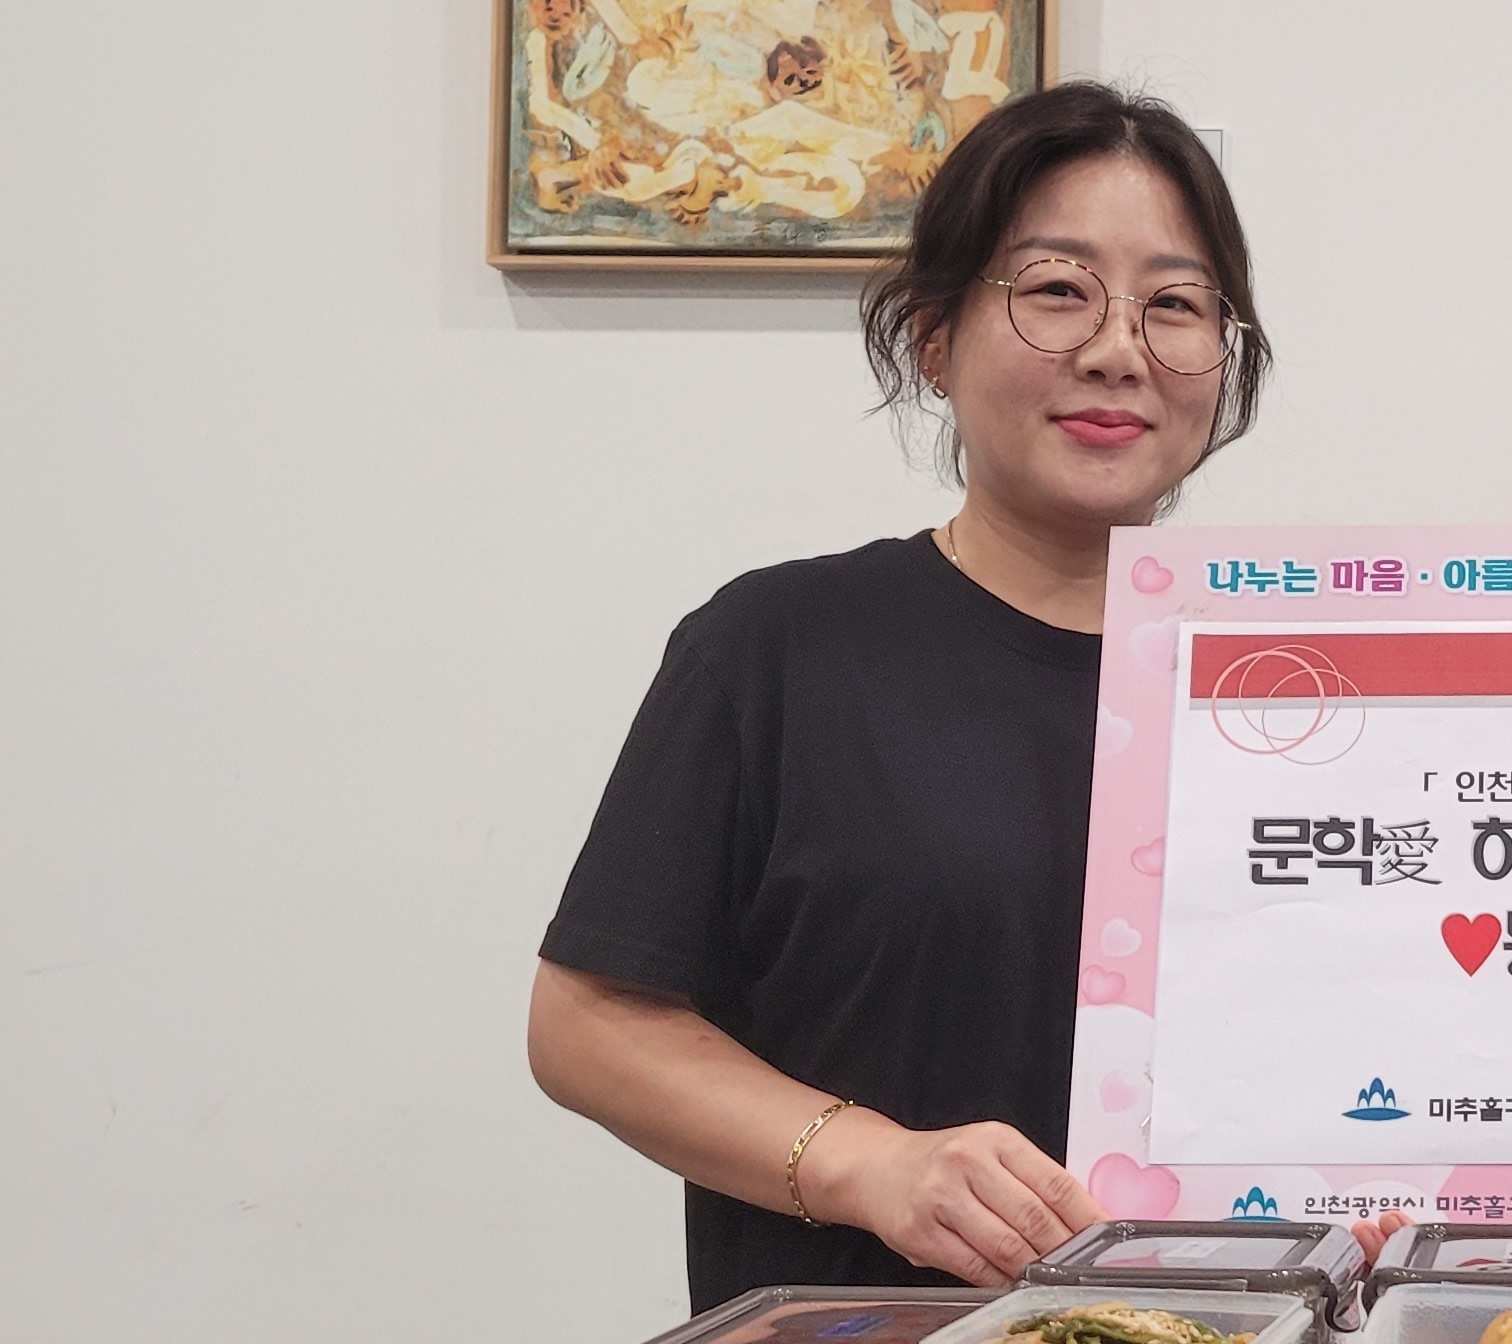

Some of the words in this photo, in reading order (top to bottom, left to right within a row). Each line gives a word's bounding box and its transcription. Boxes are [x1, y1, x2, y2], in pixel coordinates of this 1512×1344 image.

[1207, 560, 1317, 593] 나누는
[1330, 559, 1405, 592] 마음
[1246, 816, 1443, 887] 문학愛
